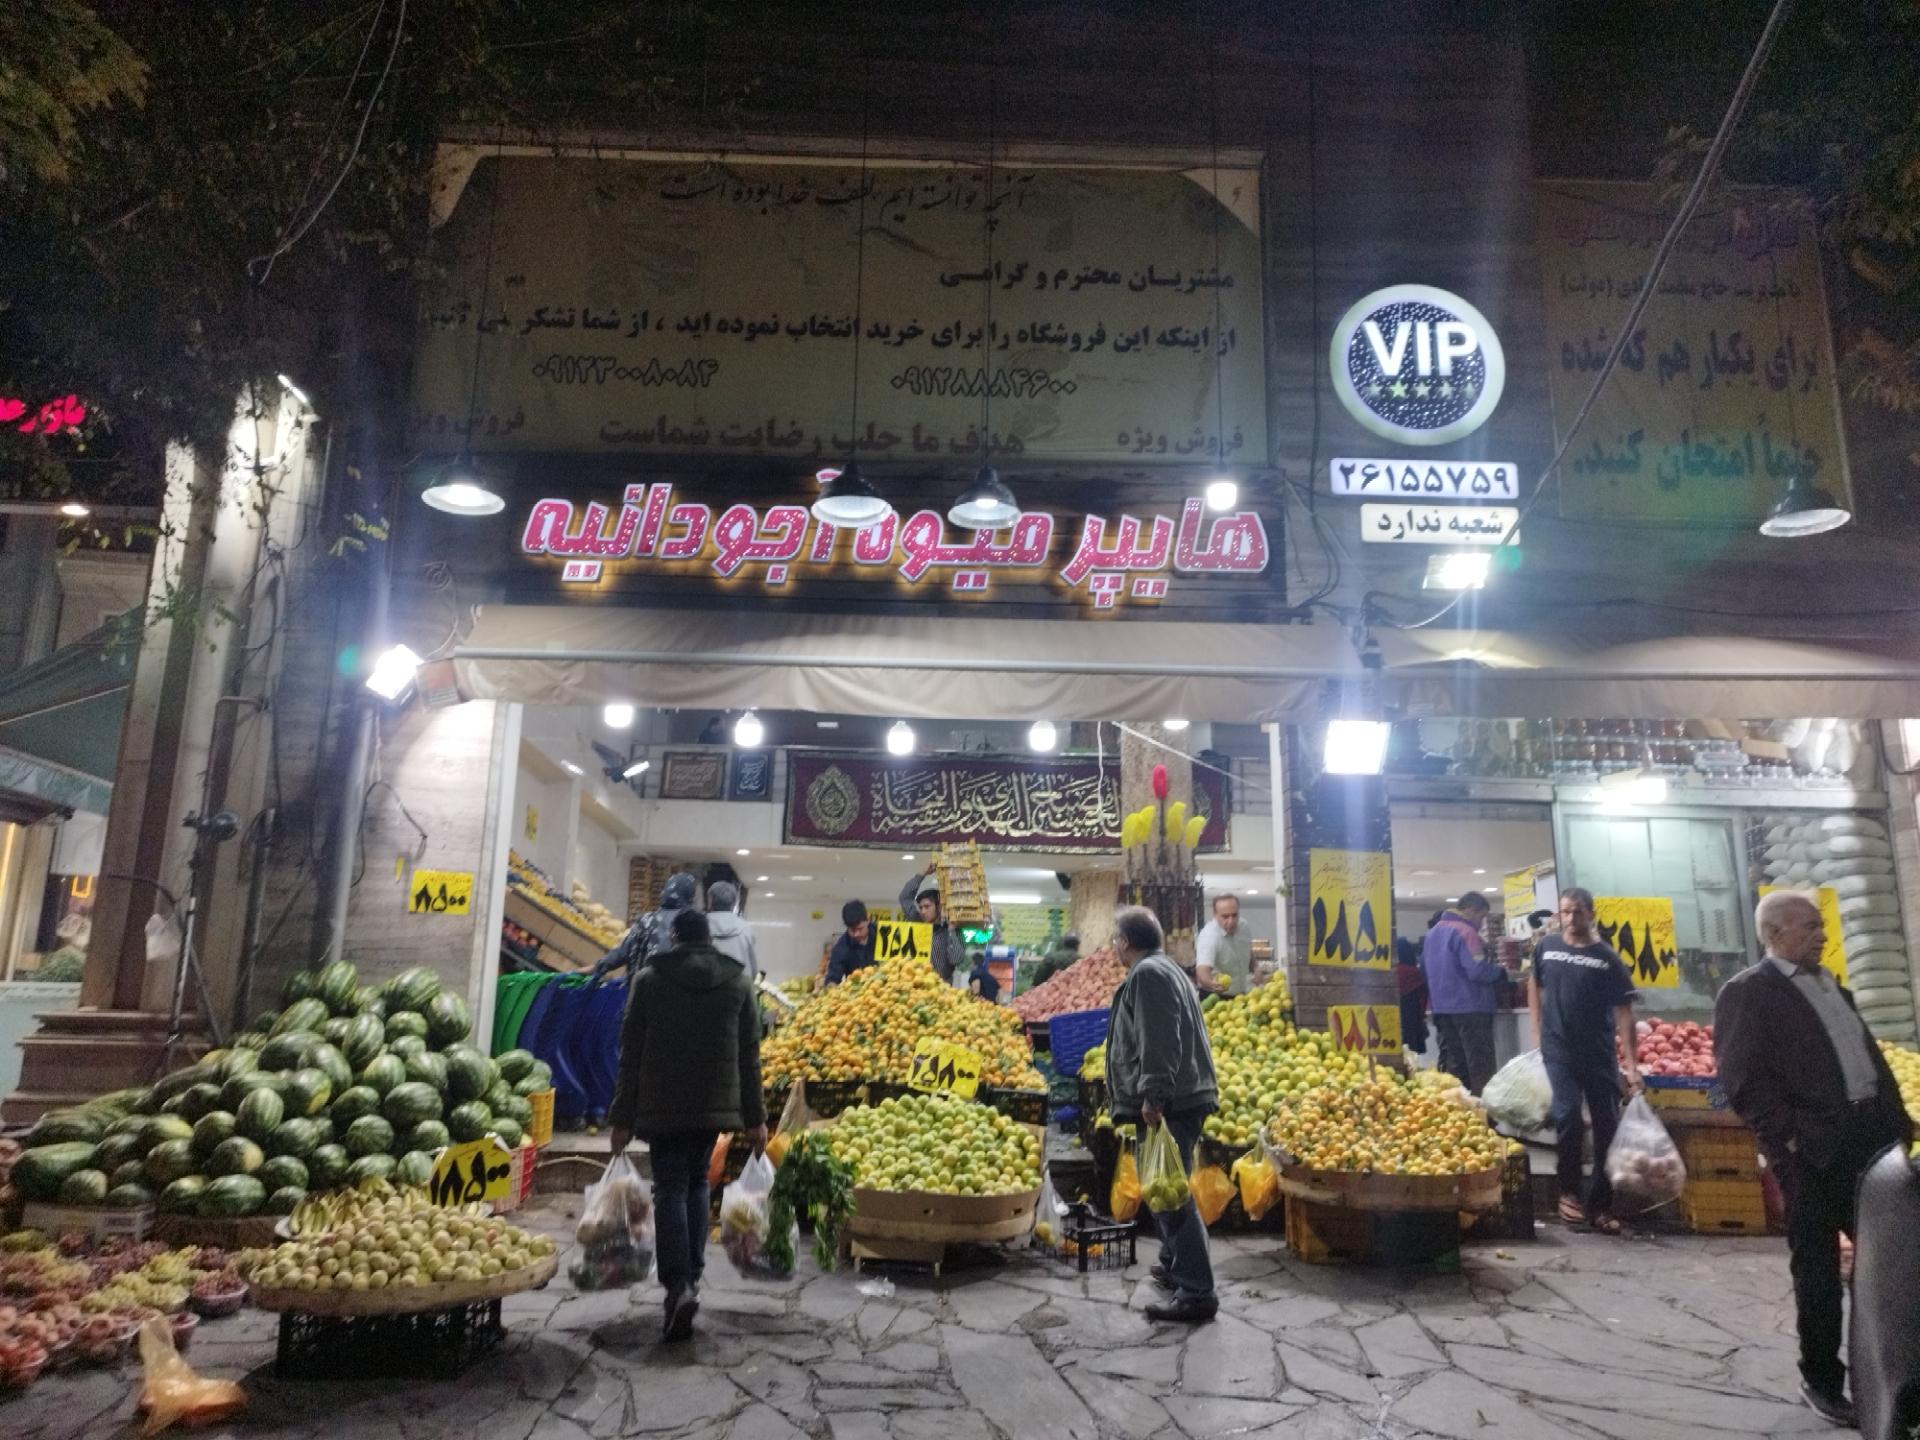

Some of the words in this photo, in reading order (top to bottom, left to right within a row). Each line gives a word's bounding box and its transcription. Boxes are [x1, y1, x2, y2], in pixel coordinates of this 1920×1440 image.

[1035, 271, 1048, 290] و
[1053, 266, 1122, 291] محترم
[520, 306, 576, 335] تشکر
[583, 307, 622, 331] شما
[626, 309, 648, 338] از
[717, 314, 779, 342] نموده
[784, 312, 860, 342] انتخاب
[865, 318, 925, 348] خرید
[930, 319, 987, 350] برای
[990, 319, 1010, 351] را
[1016, 320, 1107, 353] فروشگاه
[1112, 324, 1150, 353] این
[1155, 325, 1210, 353] اینکه
[1216, 328, 1236, 355] از
[1363, 321, 1480, 377] VIP
[1657, 337, 1690, 389] هم
[599, 414, 710, 445] شماست
[720, 415, 822, 456] رضایت
[911, 421, 940, 452] ما
[1116, 425, 1168, 455] ویژه
[1175, 424, 1244, 458] فروش
[1656, 428, 1754, 492] امتحان
[1339, 461, 1511, 495] ۲۶۱۵۵۷۵۹
[521, 467, 842, 584] آجودانیه
[1377, 509, 1442, 540] ندارد
[1448, 511, 1503, 540] شعبه
[853, 500, 1055, 590] میوه
[1060, 495, 1270, 608] هایپر
[414, 882, 466, 914] ۸۵۰۰
[879, 924, 929, 958] ۲۵۸۰۰
[1312, 895, 1389, 963] ۱۸۵۰۰
[1330, 1005, 1397, 1052] ۱۸۵۰۰
[911, 1053, 976, 1089] ۲۵۸۰۰
[430, 1150, 511, 1209] ۱۸۵۰۰
